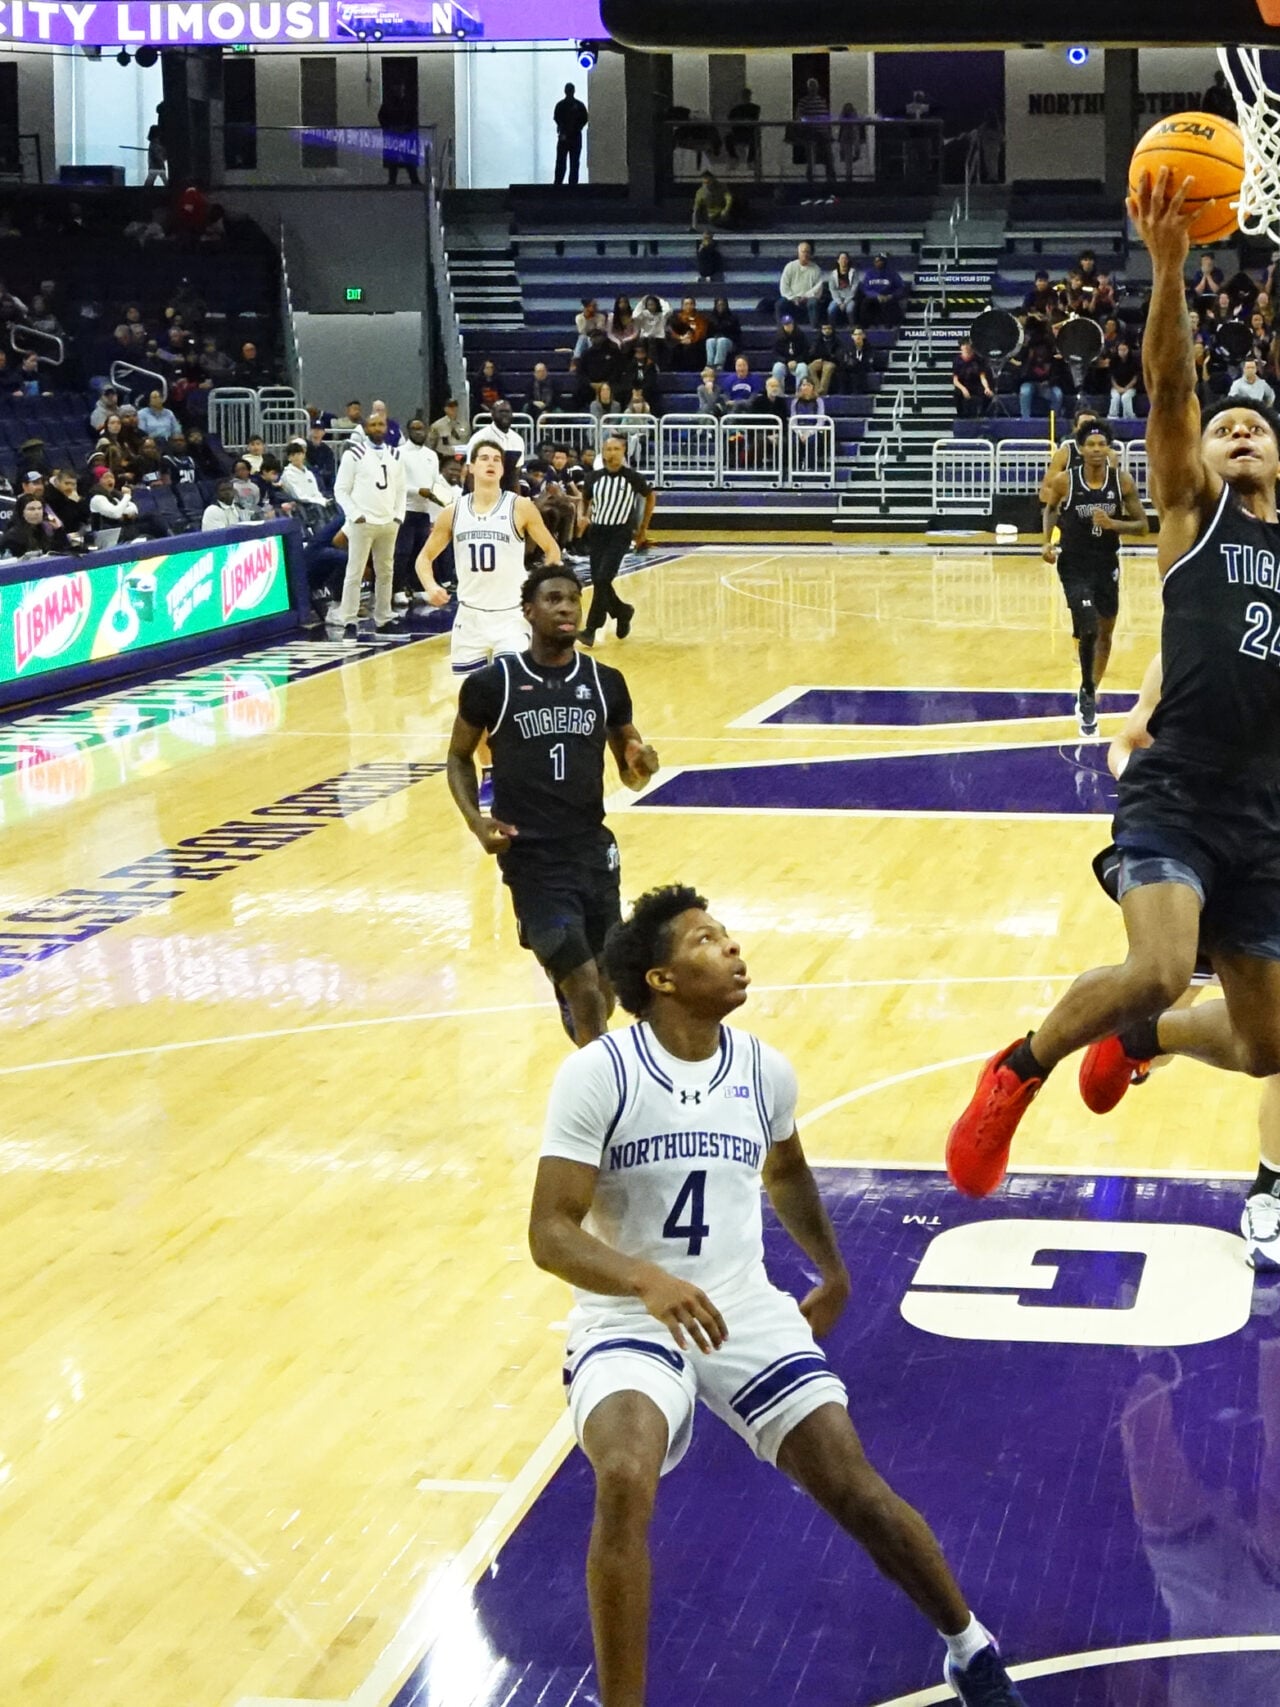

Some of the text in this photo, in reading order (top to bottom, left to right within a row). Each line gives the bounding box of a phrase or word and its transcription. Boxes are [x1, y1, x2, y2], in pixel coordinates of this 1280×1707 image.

[117, 1, 330, 41] LIMOUSI
[432, 3, 453, 34] N
[1159, 122, 1216, 140] NCAA
[374, 464, 389, 490] J
[455, 530, 511, 544] NORTHWESTERN
[1091, 522, 1103, 537] 4
[468, 543, 496, 572] 10
[222, 540, 273, 616] LIBMAN
[15, 574, 84, 667] LIBMAN
[513, 706, 597, 739] TIGERS
[549, 743, 565, 780] 1
[0, 763, 448, 979] ELSH-RYAN ARENA
[609, 1131, 762, 1171] NORTHWESTERN
[662, 1169, 710, 1256] 4
